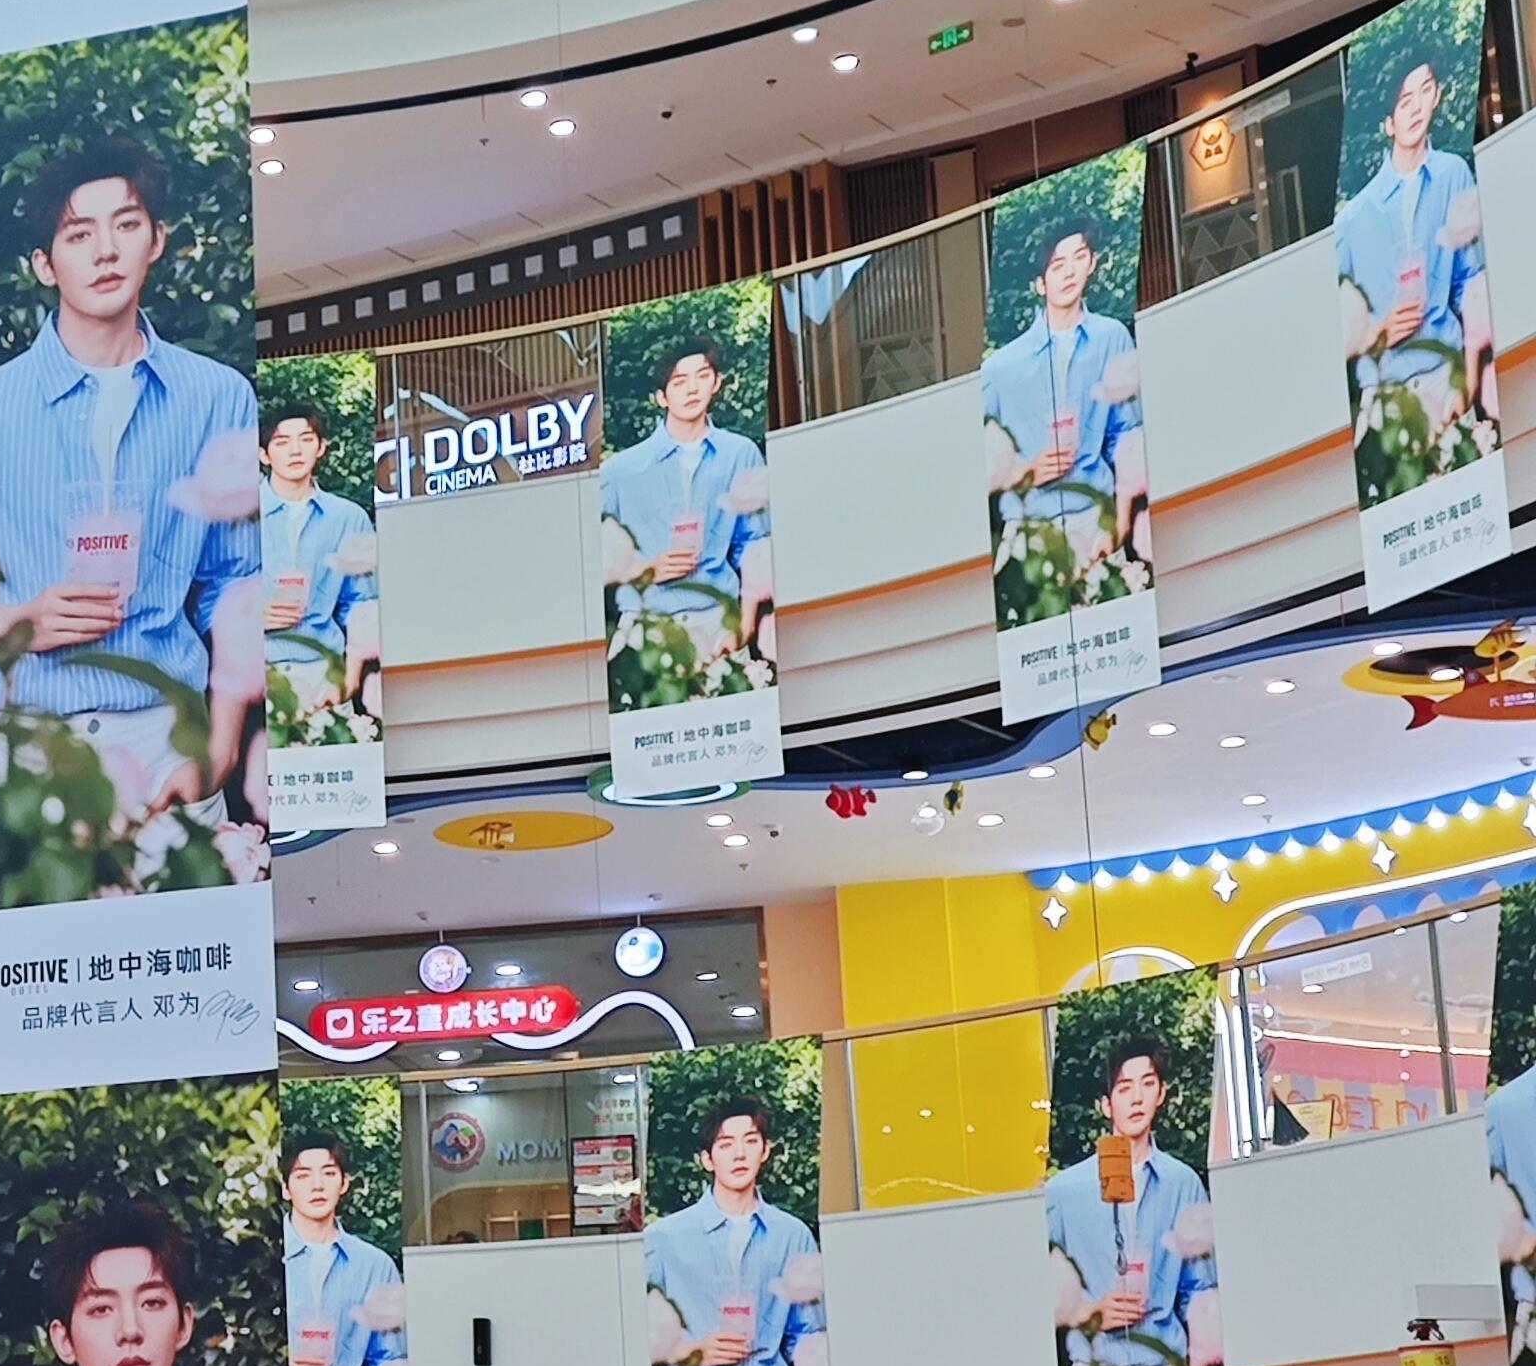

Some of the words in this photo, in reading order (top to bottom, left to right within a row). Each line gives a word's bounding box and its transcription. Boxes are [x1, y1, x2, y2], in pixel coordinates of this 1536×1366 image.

[424, 393, 594, 474] DOLBY
[425, 464, 496, 496] CINEMA
[519, 442, 587, 474] 杜比影院
[77, 534, 128, 552] POSITIVE
[88, 943, 231, 981] 地中海咖啡
[22, 996, 143, 1030] 品牌代言人
[152, 993, 199, 1017] 邓为
[362, 995, 557, 1035] 乐之童成长中心
